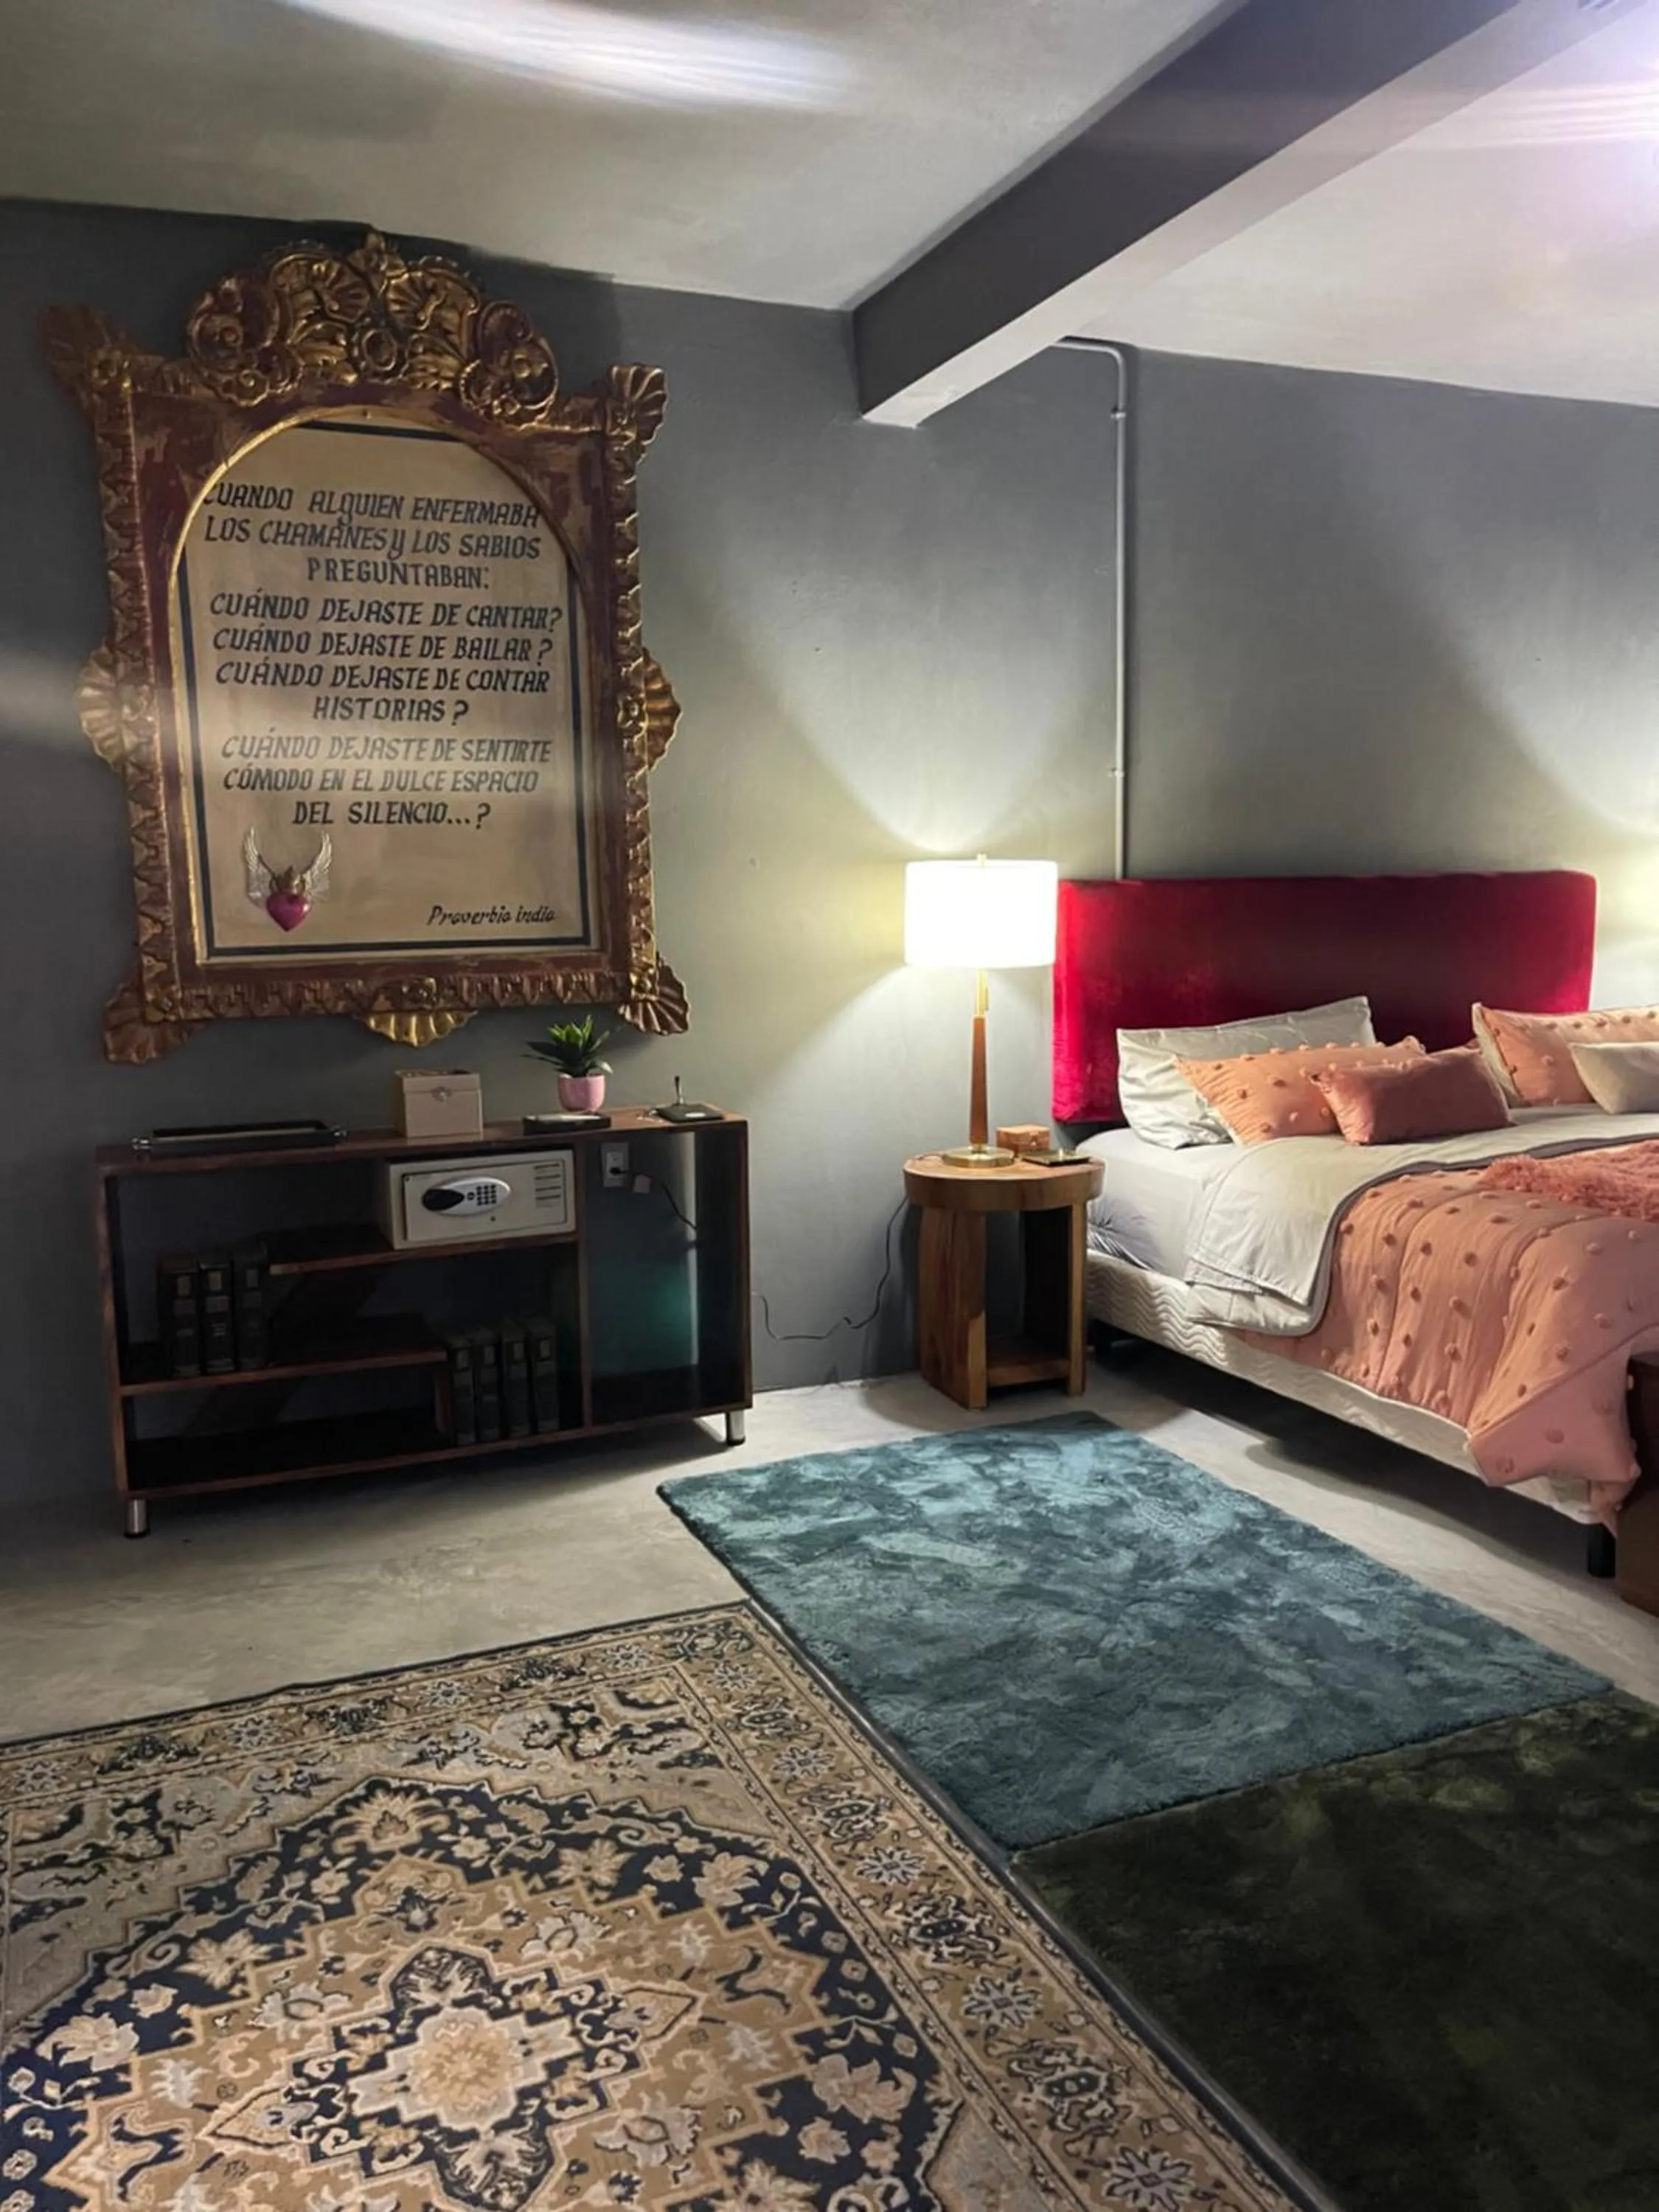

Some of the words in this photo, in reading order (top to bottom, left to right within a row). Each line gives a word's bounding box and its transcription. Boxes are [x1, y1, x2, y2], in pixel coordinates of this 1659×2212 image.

[410, 496, 541, 528] ENFERMABA
[204, 515, 251, 542] LOS
[411, 529, 451, 554] LOS
[459, 533, 542, 560] SABIOS
[307, 557, 490, 590] PREGUNTABAN:
[210, 588, 310, 620] CUÁNDO
[319, 597, 423, 627] DEJASTE
[430, 602, 462, 627] DE
[465, 605, 563, 633] CANTAR?
[213, 623, 311, 655] CUÁNDO
[316, 630, 414, 658] DEJASTE
[417, 636, 448, 659] DE
[216, 656, 323, 687] CUÁNDO
[330, 664, 431, 690] DEJASTE
[432, 667, 462, 692] DE
[465, 669, 550, 694] CONTAR
[221, 727, 321, 759] CUÁNDO
[327, 737, 429, 762] DEJASTE
[430, 738, 458, 762] DE
[461, 740, 552, 763] SENTIRTE
[223, 762, 314, 791] CÓMODO
[319, 768, 346, 791] EN
[352, 769, 373, 792] EL
[378, 770, 447, 793] DULCE
[451, 771, 540, 793] ESPACIO
[292, 801, 334, 825] DEL
